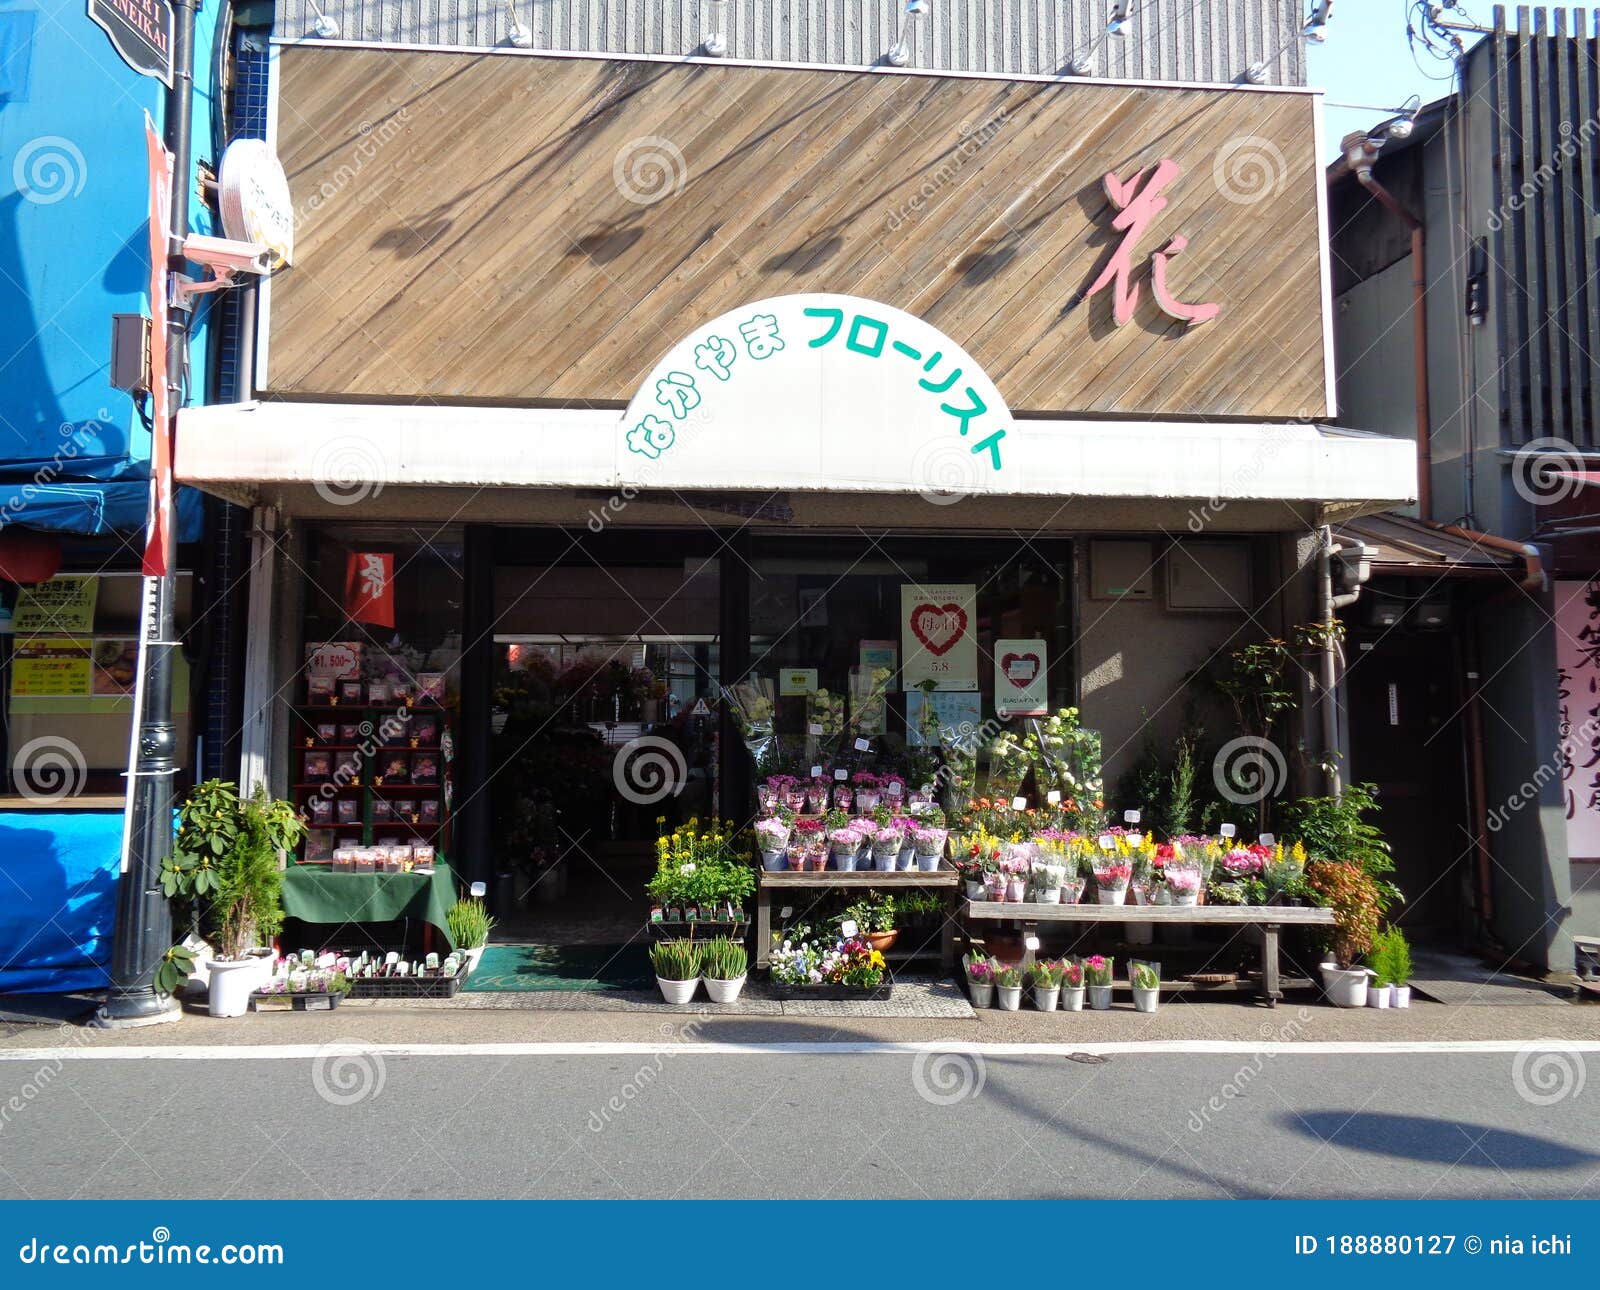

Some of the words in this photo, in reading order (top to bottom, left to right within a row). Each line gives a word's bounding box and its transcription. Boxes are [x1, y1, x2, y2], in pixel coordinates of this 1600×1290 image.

[1079, 158, 1220, 327] 花
[626, 314, 785, 459] なかやま
[803, 307, 1006, 470] フローリスト
